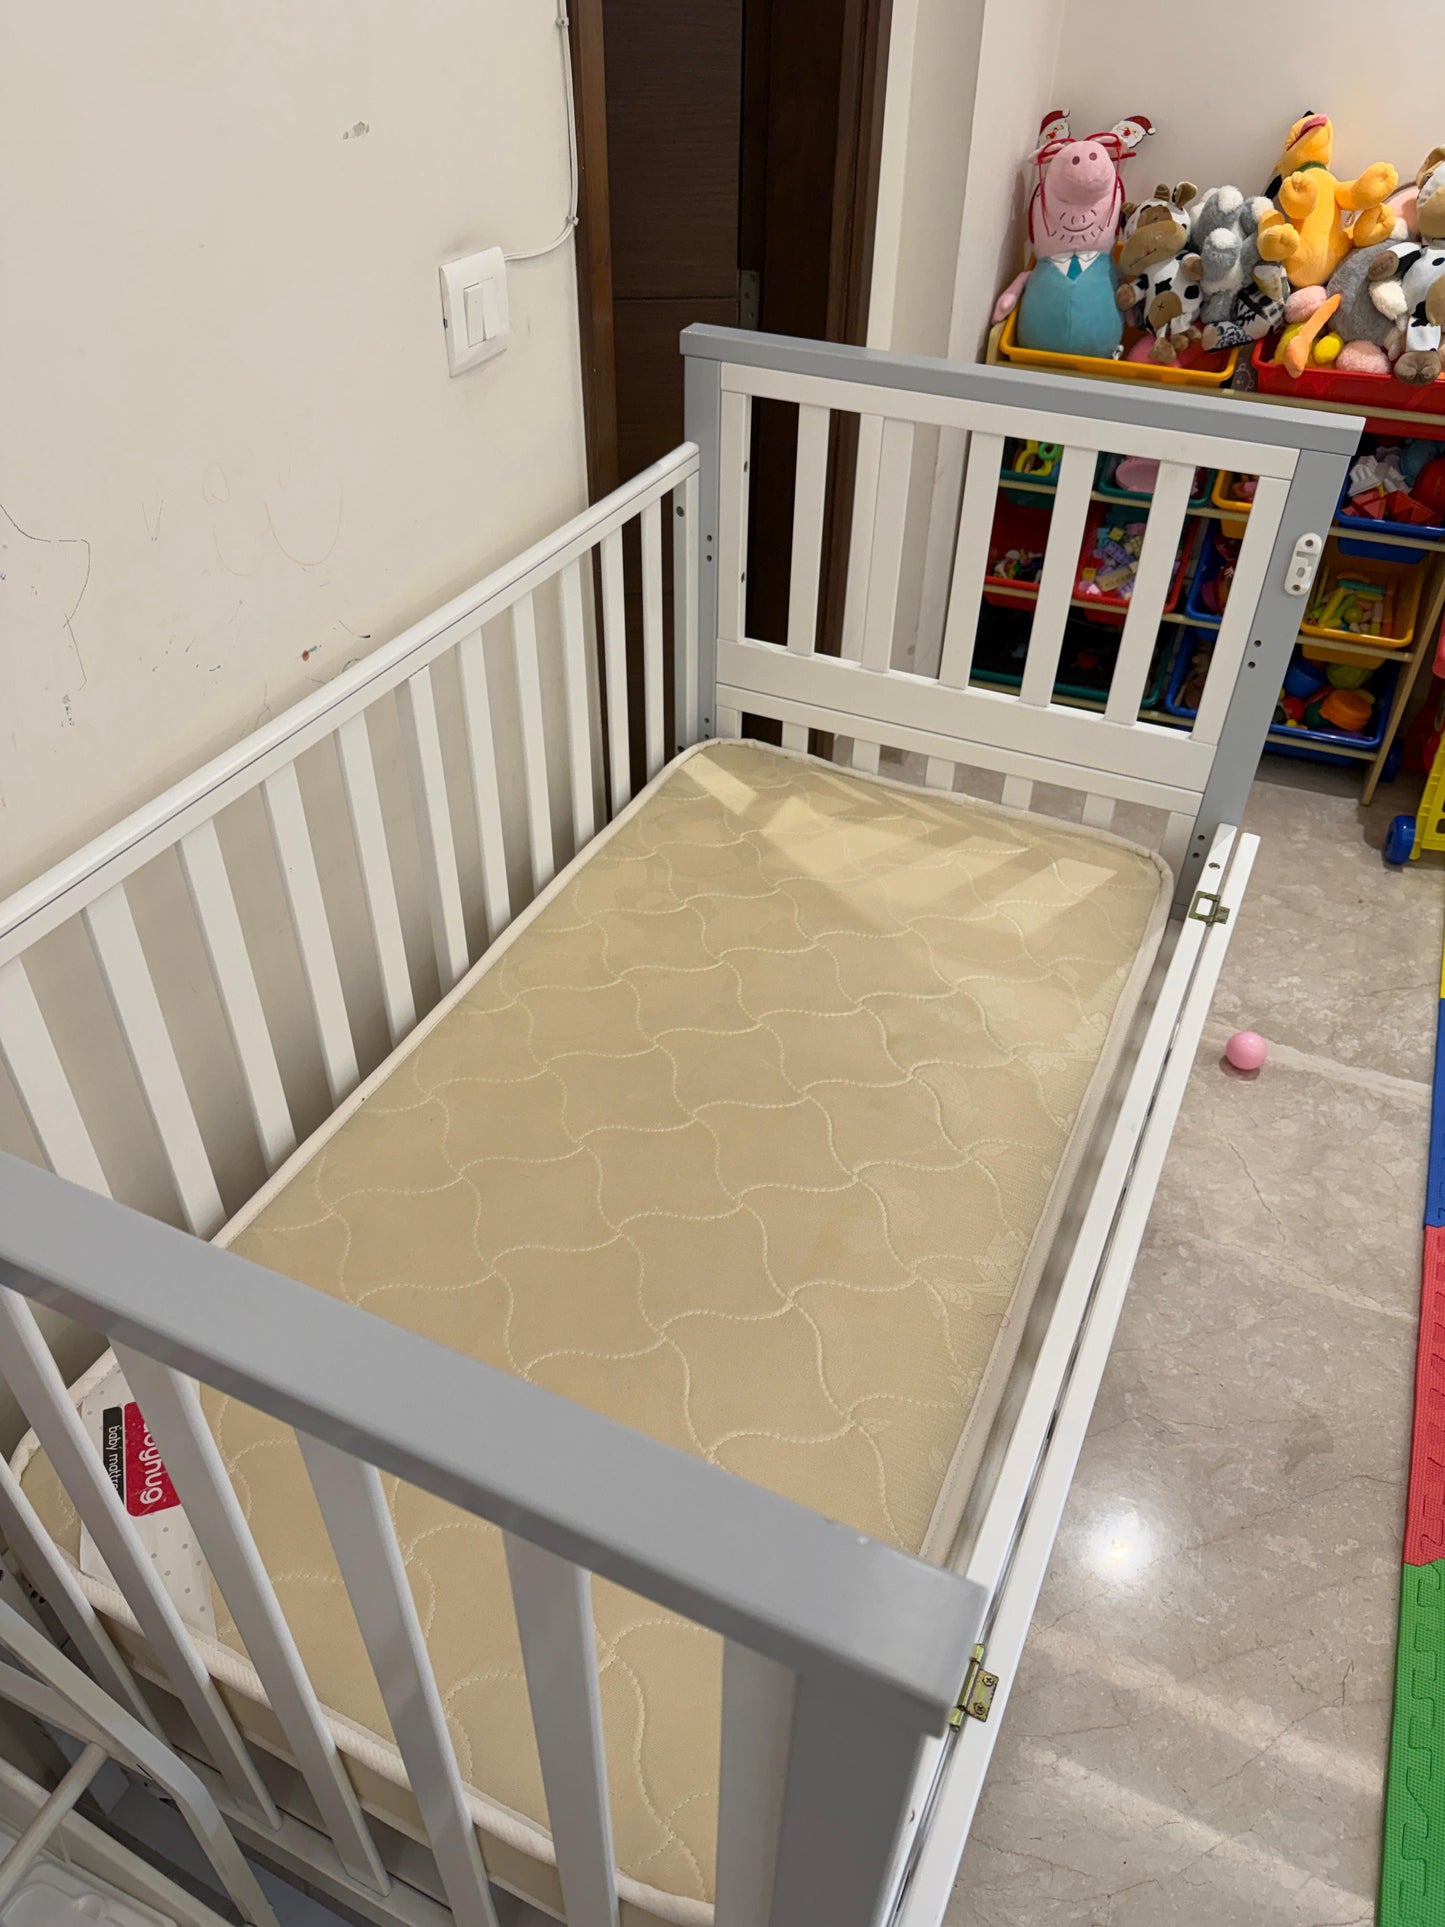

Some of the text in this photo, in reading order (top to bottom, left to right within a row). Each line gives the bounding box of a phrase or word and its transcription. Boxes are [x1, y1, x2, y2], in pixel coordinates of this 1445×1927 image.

[105, 1425, 121, 1489] baby mattr
[139, 1423, 163, 1504] yhug
